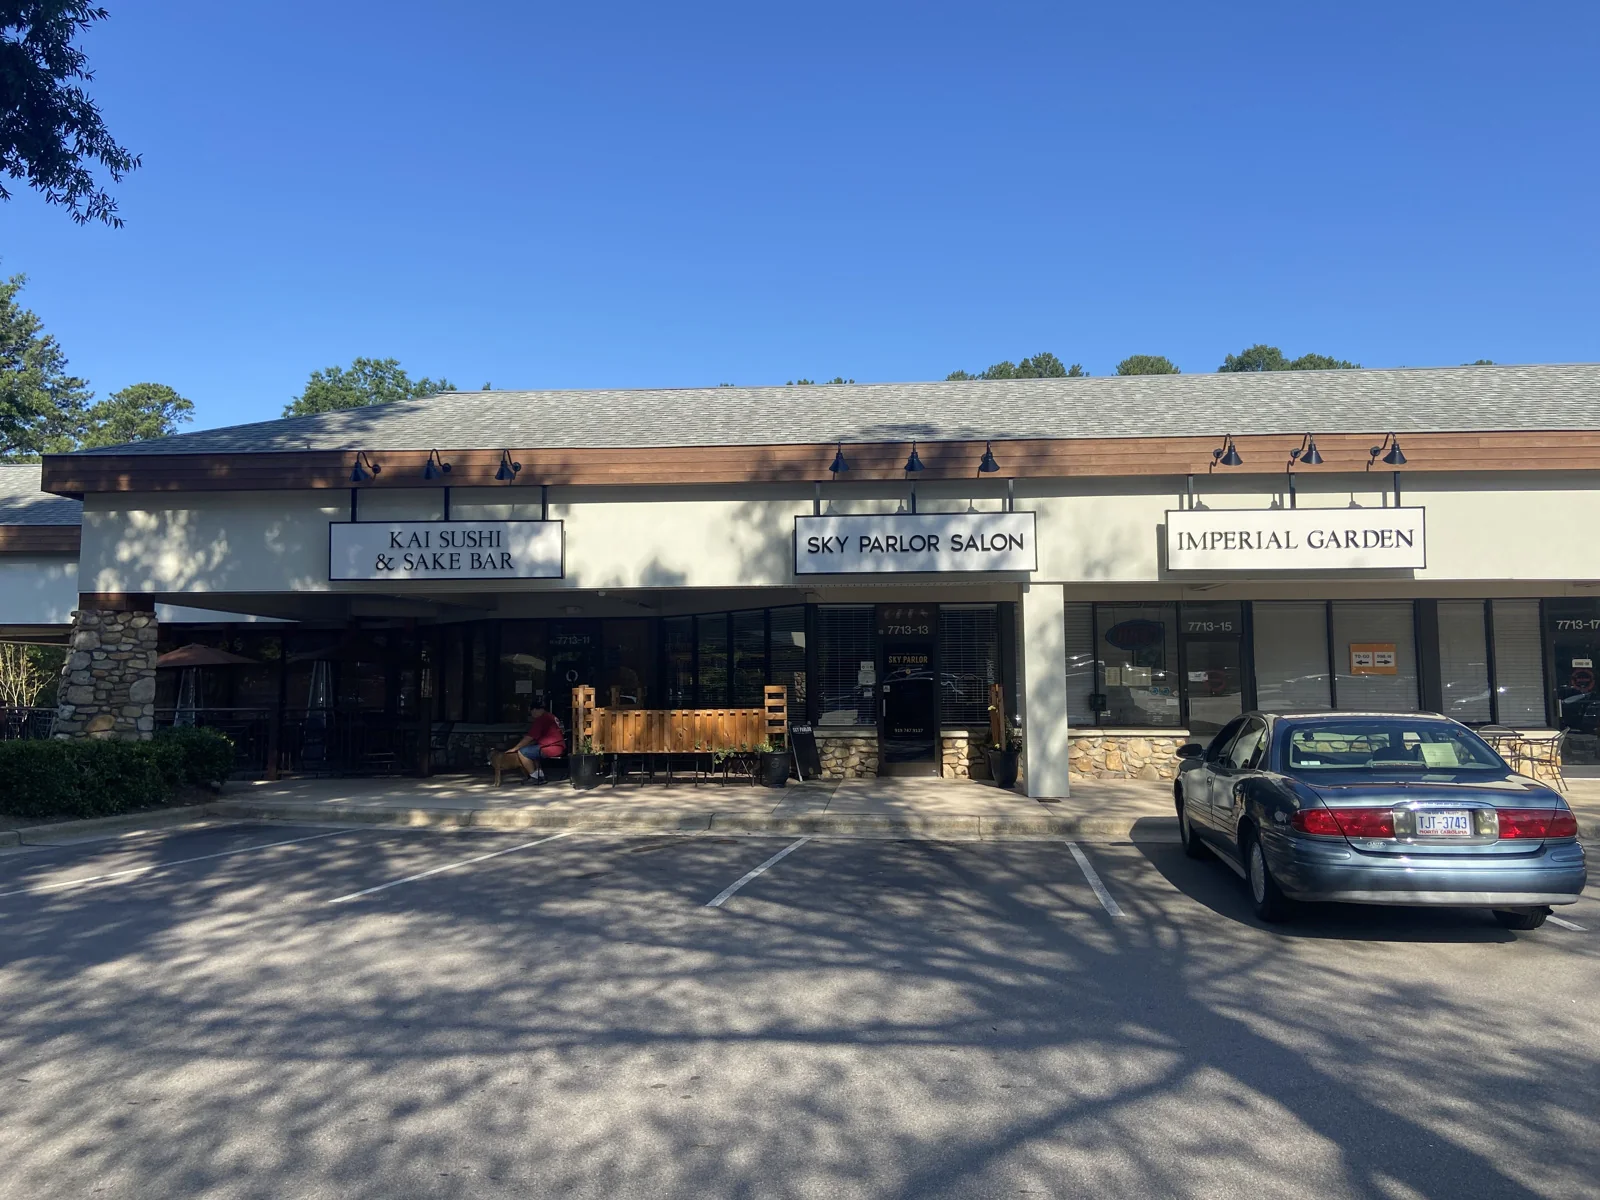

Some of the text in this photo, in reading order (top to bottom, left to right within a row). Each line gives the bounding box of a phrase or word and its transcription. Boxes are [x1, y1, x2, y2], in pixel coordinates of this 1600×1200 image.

[389, 530, 502, 549] KAI SUSHI
[807, 533, 1024, 554] SKY PARLOR SALON
[1177, 529, 1415, 551] IMPERIAL GARDEN
[375, 552, 514, 571] & SAKE BAR
[887, 625, 929, 635] 7713-13
[1188, 621, 1232, 632] 7713-15
[556, 635, 590, 645] 7713-11
[888, 655, 928, 664] SKY PARLOR
[1418, 816, 1467, 829] TJT-3743
